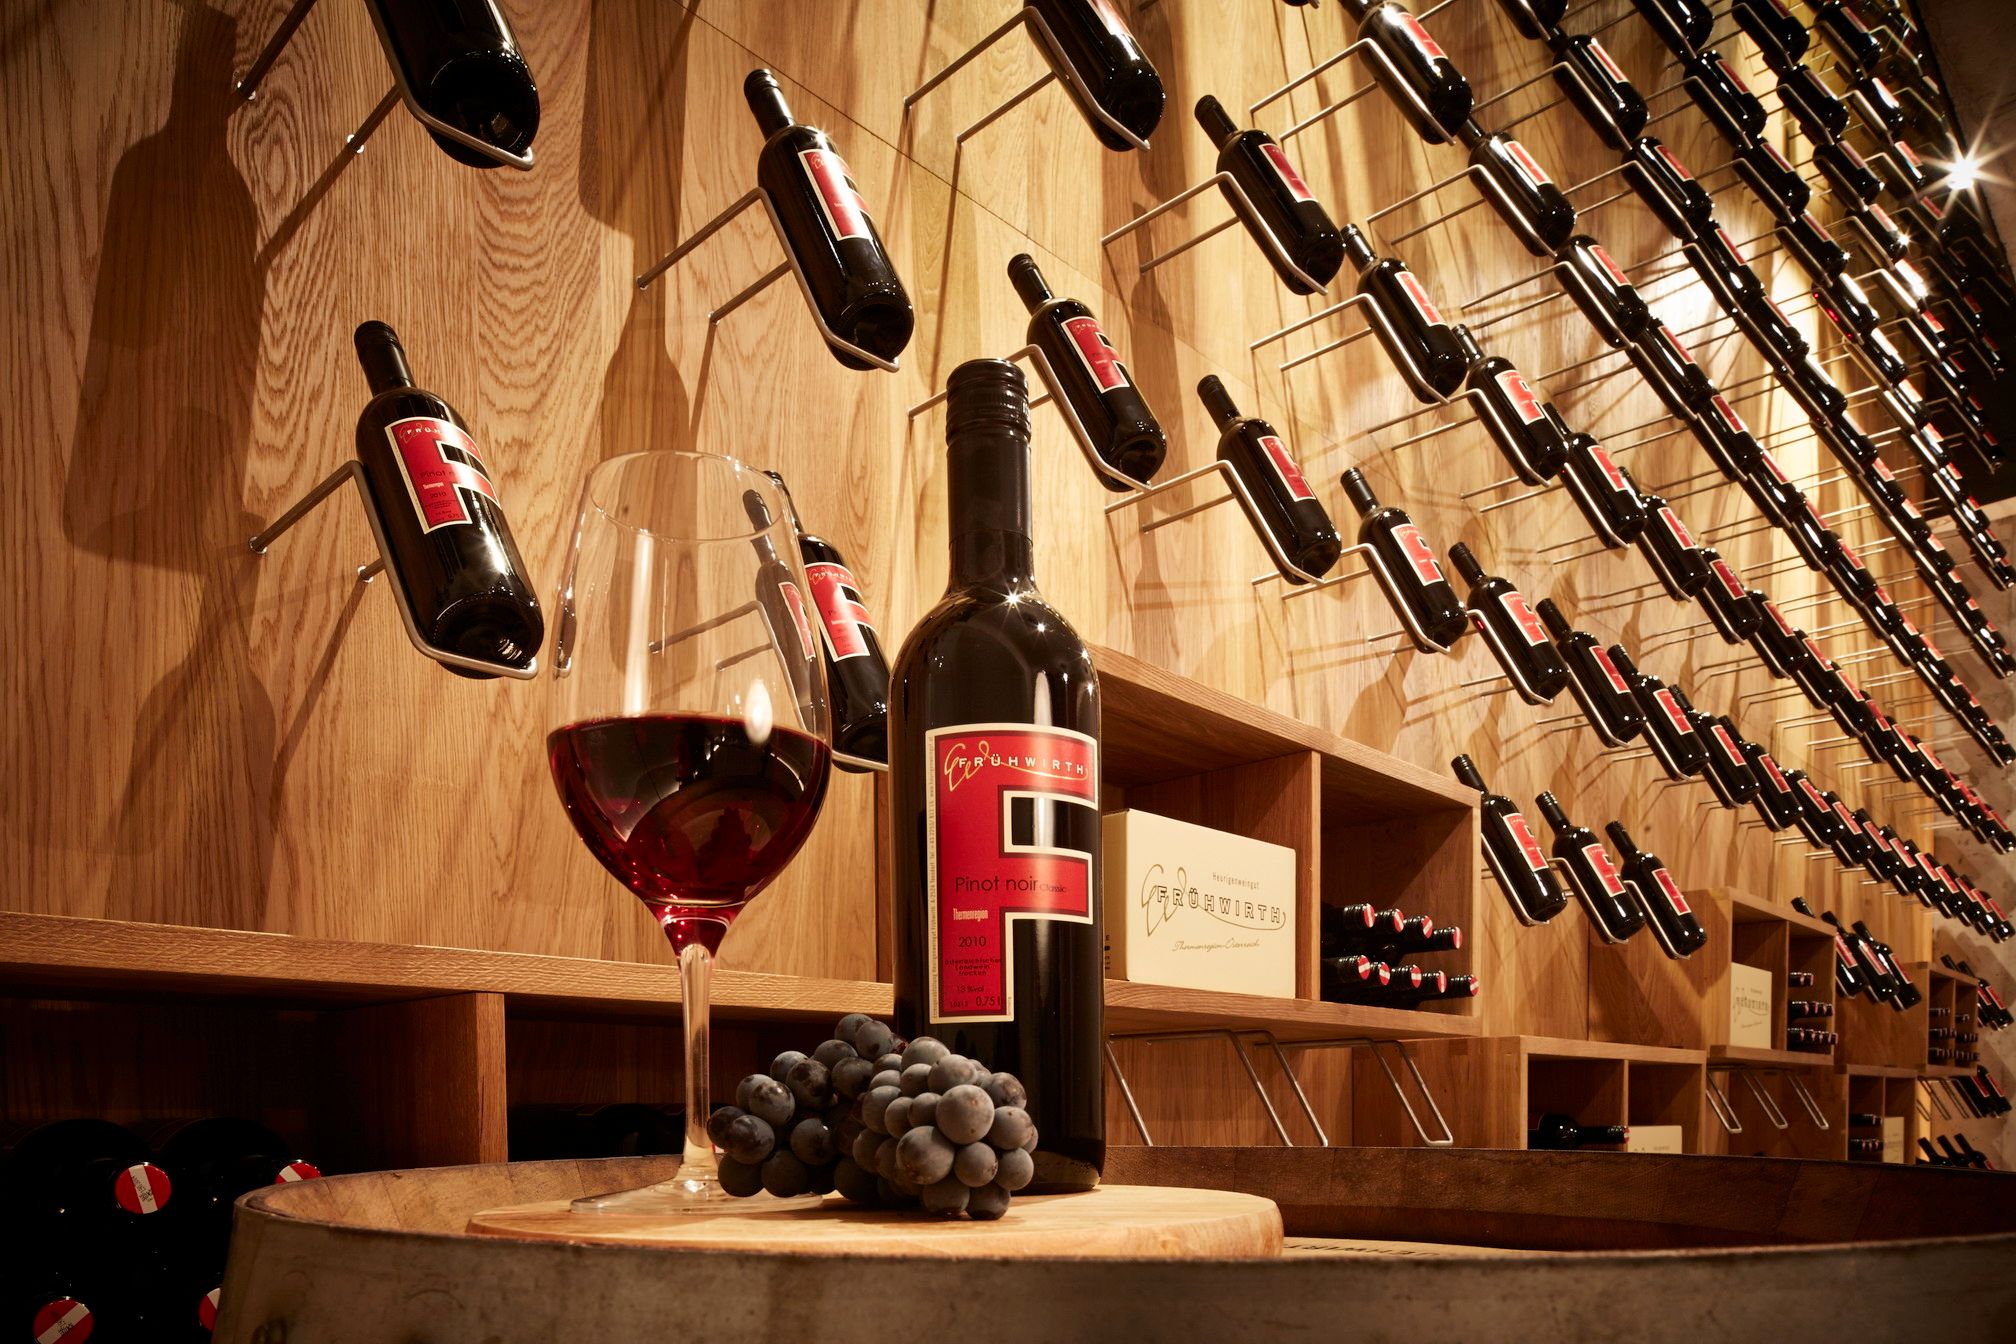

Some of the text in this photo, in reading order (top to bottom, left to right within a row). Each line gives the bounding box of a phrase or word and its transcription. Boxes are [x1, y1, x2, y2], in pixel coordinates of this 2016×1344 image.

[959, 754, 1083, 775] FRÜHWIRTH
[955, 876, 1000, 893] Pinot
[1006, 876, 1038, 891] noir
[1157, 885, 1281, 924] FRÜHWIRTH
[959, 936, 987, 947] 2010
[976, 996, 995, 1006] 0,75
